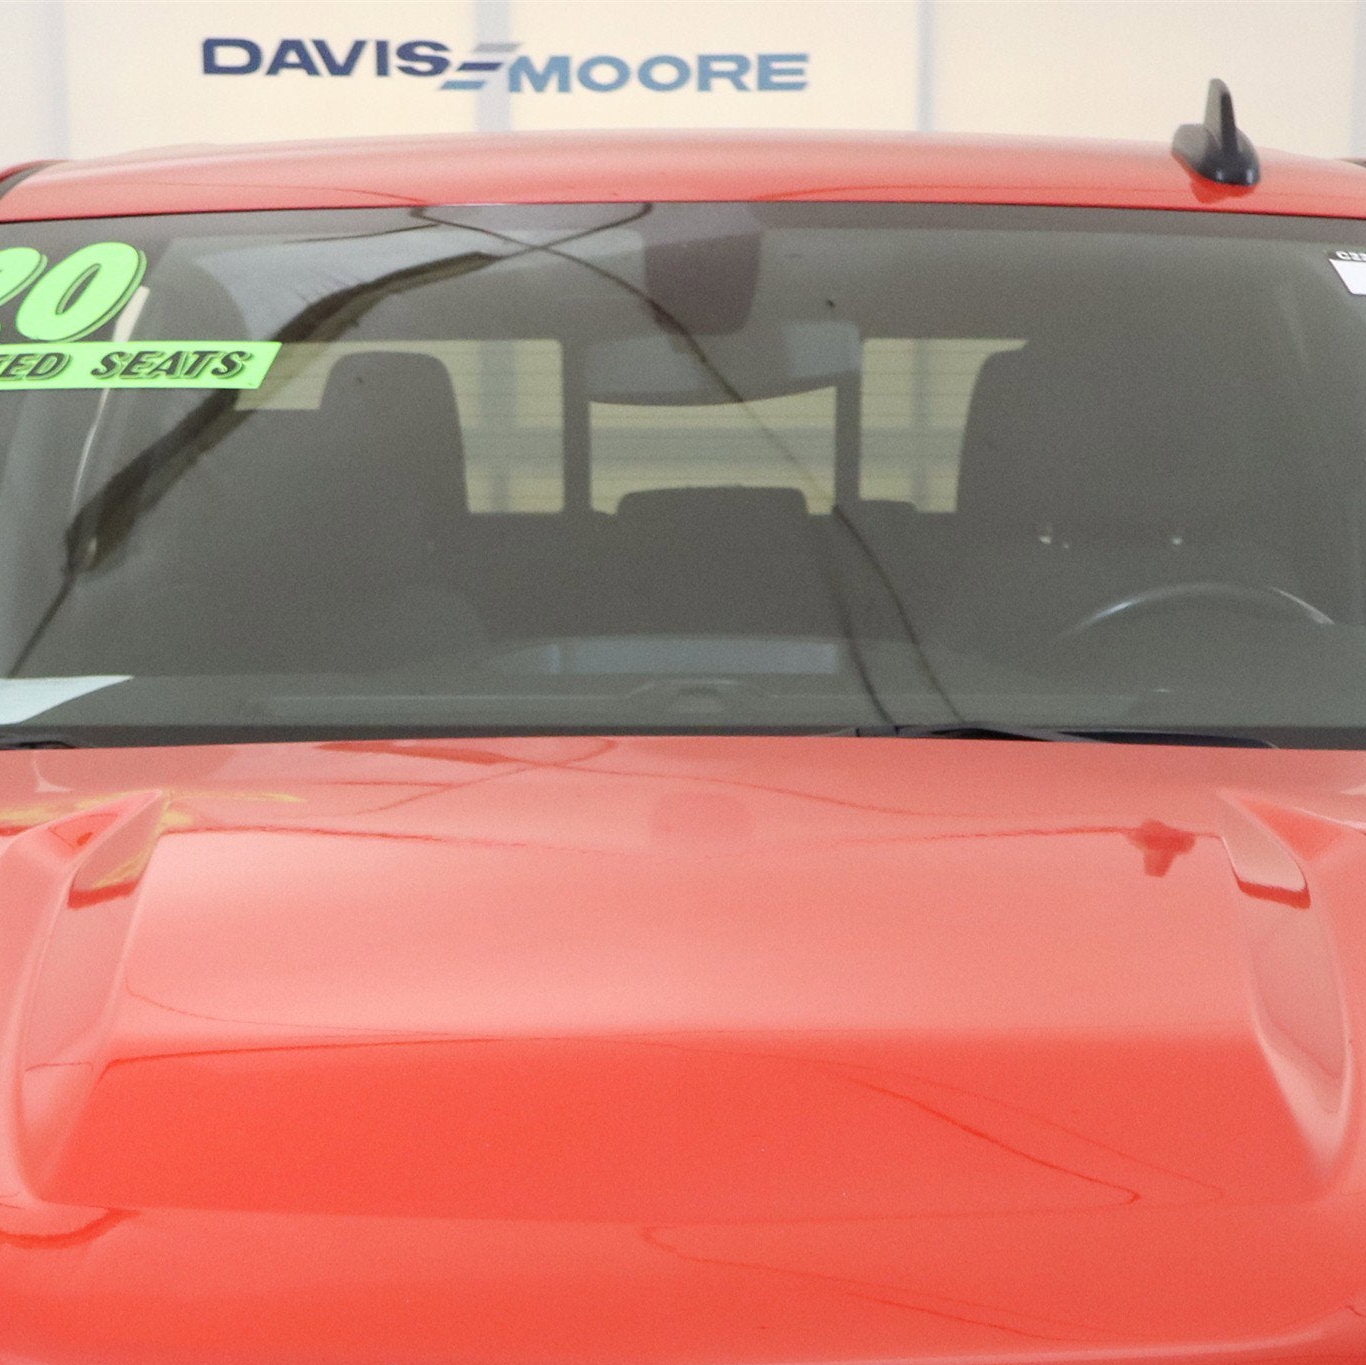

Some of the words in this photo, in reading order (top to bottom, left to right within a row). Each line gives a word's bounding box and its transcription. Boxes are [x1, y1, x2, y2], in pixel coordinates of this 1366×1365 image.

[201, 37, 452, 78] DAVIS
[507, 52, 810, 94] MOORE
[91, 350, 254, 380] SEATS
